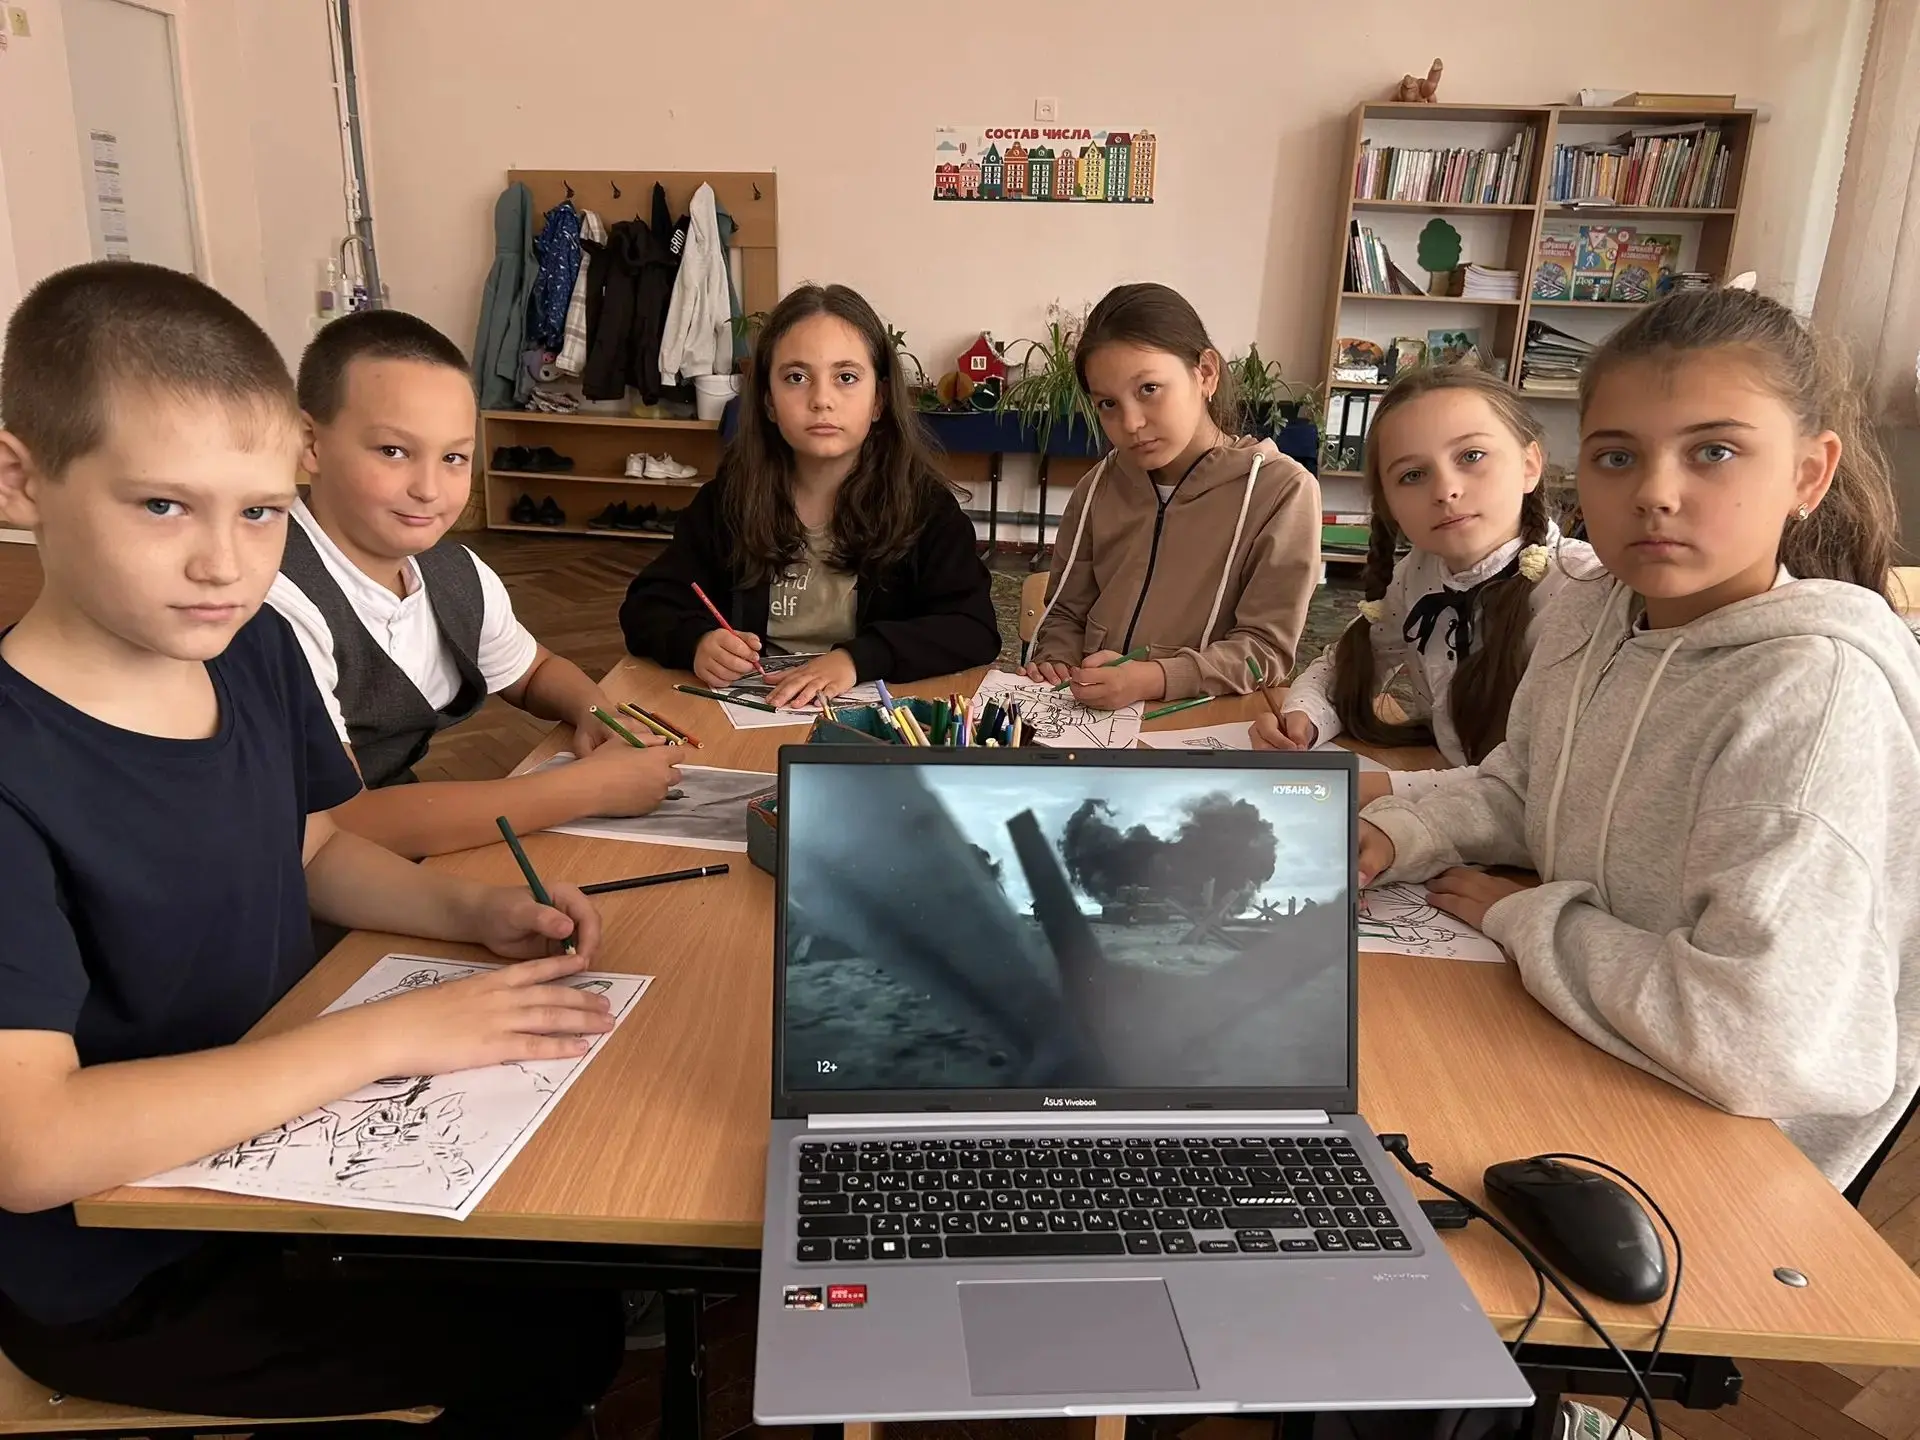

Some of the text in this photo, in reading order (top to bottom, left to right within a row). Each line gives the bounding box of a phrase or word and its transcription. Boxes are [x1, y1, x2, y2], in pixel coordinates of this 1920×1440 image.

[985, 128, 1091, 139] СОСТАВ ЧИСЛА
[1272, 785, 1311, 795] КУБАНЬ
[816, 1060, 838, 1073] 12+
[1064, 1098, 1097, 1106] Vivobook
[881, 1176, 894, 1184] W
[918, 1175, 924, 1183] E
[952, 1174, 959, 1182] R
[987, 1174, 992, 1182] T
[1053, 1173, 1062, 1181] U
[858, 1198, 867, 1206] A
[894, 1196, 902, 1205] S
[928, 1196, 937, 1204] D
[964, 1195, 970, 1203] F
[997, 1194, 1008, 1203] G
[1032, 1194, 1042, 1202] H
[1070, 1194, 1075, 1202] J
[1102, 1193, 1110, 1201] K
[878, 1215, 1102, 1228] Z X C V B N M
